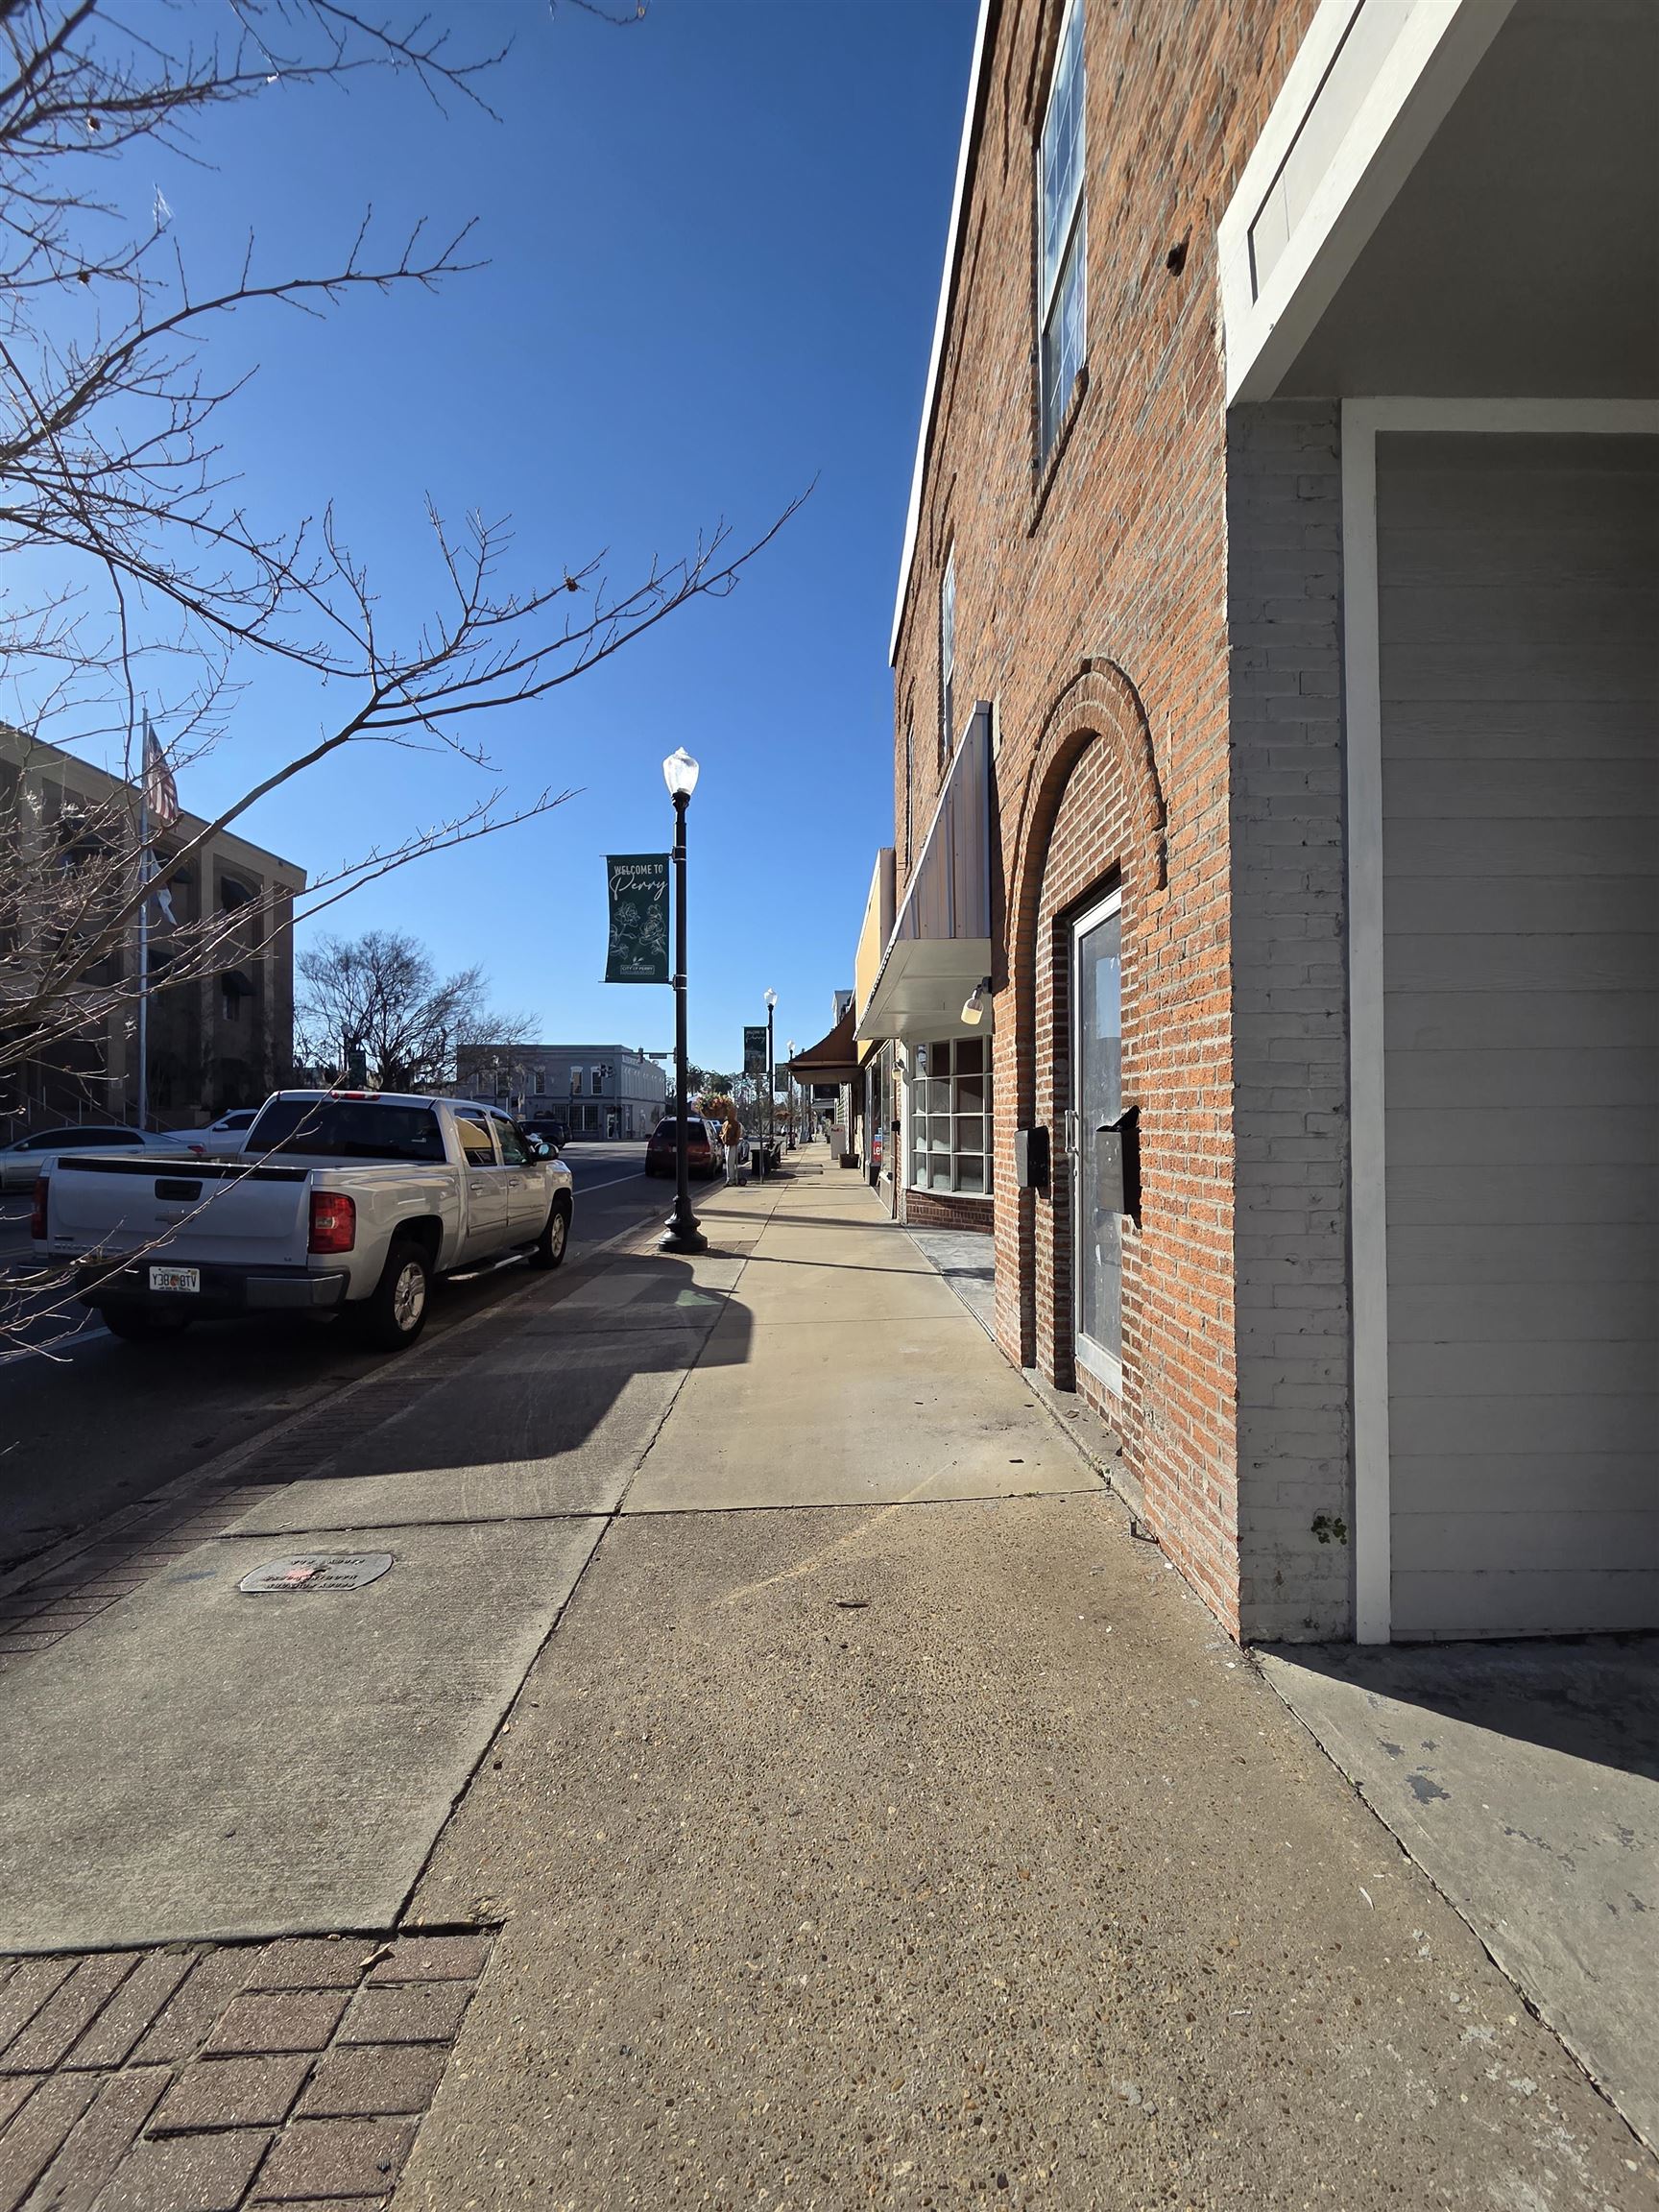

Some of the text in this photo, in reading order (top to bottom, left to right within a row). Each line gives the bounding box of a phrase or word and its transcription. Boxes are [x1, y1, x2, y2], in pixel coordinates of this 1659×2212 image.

[614, 864, 663, 875] WELCOME TO
[609, 871, 668, 902] Perry
[152, 1273, 169, 1286] Y38
